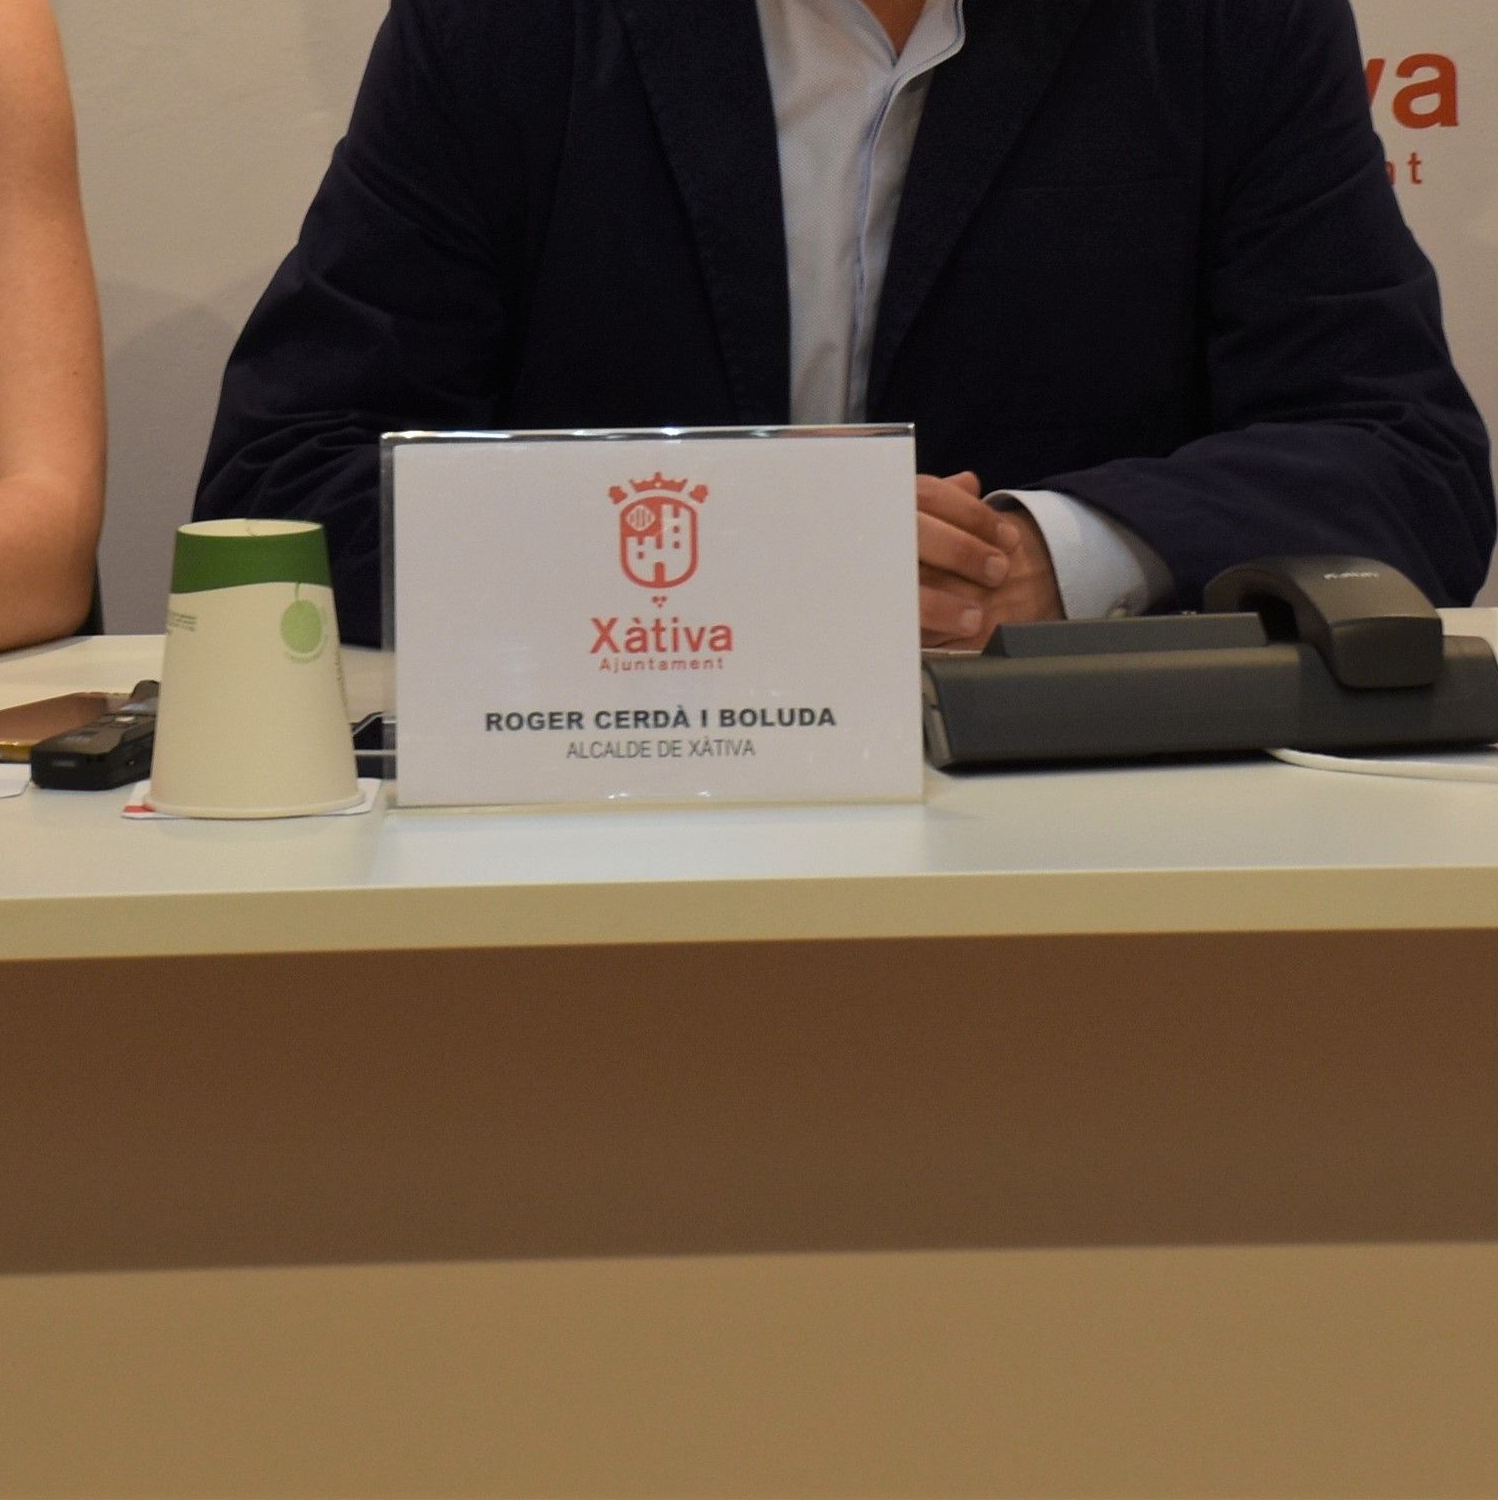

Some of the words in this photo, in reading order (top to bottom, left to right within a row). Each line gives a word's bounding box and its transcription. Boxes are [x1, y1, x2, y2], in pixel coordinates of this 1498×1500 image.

[590, 616, 734, 655] Xàtiva
[598, 656, 726, 674] Ajuntament
[484, 710, 585, 732] ROGER
[593, 704, 691, 731] CERDÀ
[699, 708, 709, 729] I
[718, 707, 837, 728] BOLUDA
[566, 740, 652, 759] ALCALDE
[656, 739, 683, 758] DE
